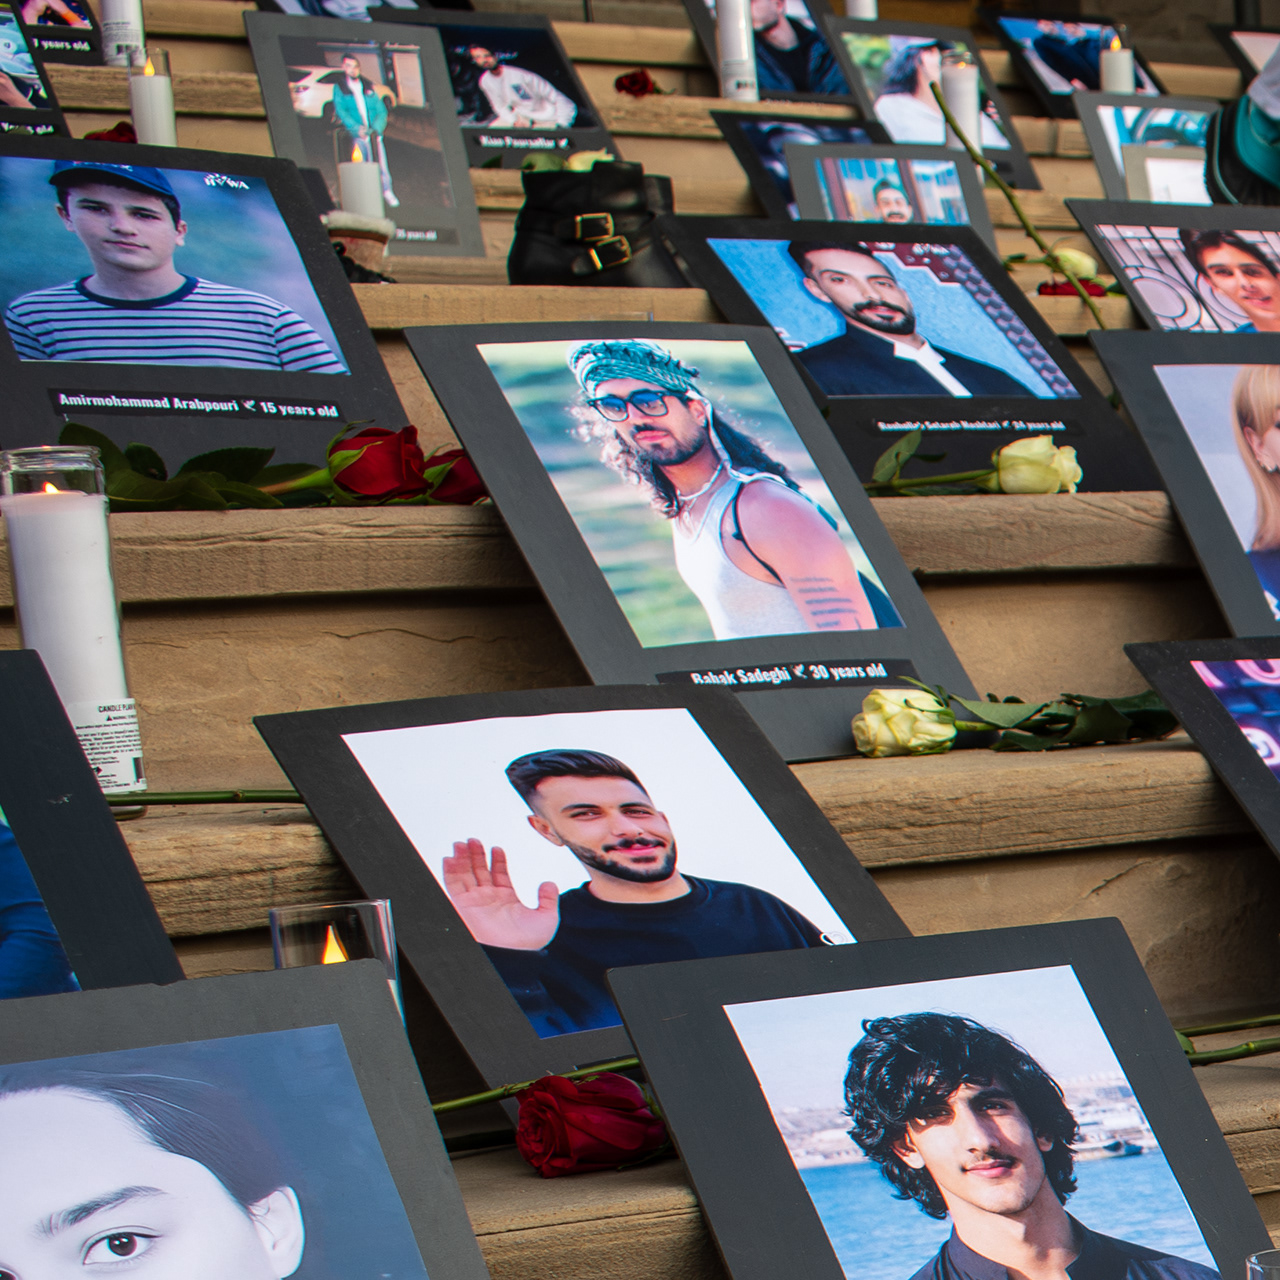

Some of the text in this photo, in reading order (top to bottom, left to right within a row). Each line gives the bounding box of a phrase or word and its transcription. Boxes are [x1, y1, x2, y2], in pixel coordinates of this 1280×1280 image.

[59, 392, 340, 418] Amirmohammad Arabpouri 15 years old
[736, 667, 792, 685] Sadeghi
[809, 664, 829, 680] 30
[829, 665, 867, 682] years
[865, 663, 888, 678] old
